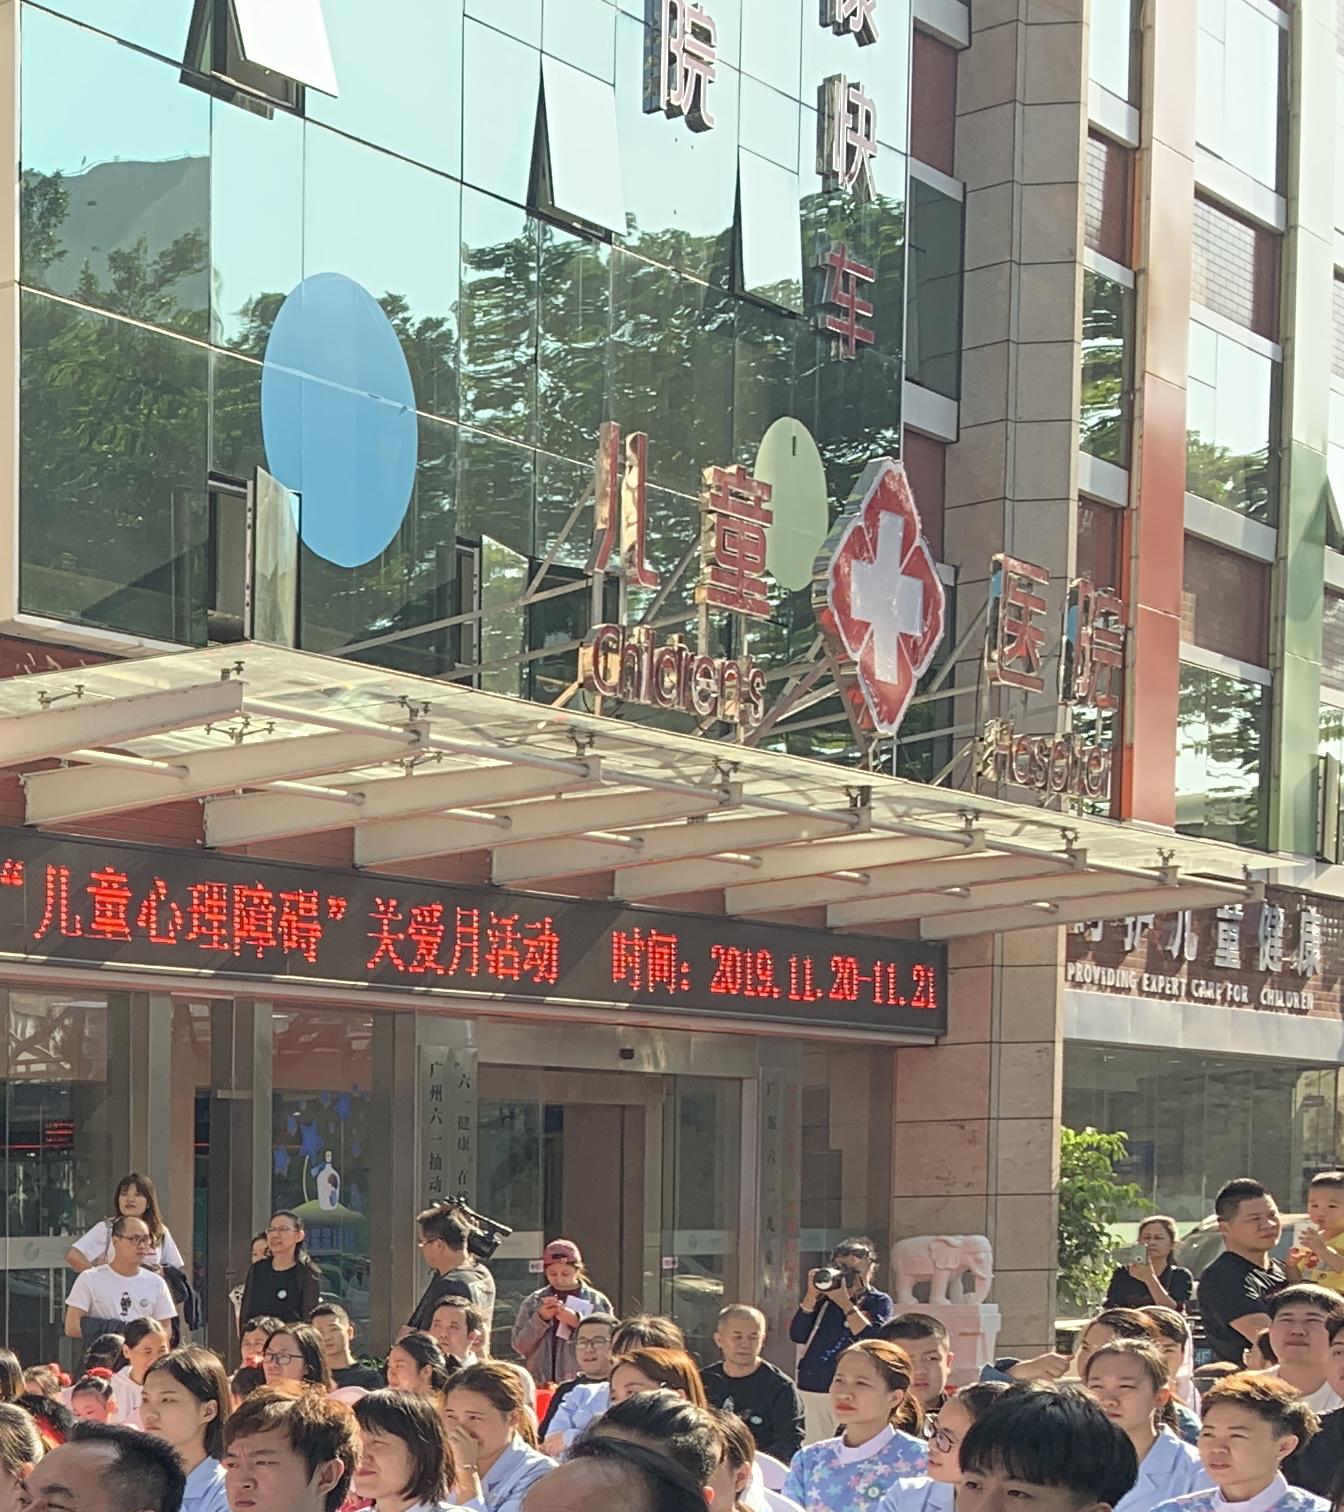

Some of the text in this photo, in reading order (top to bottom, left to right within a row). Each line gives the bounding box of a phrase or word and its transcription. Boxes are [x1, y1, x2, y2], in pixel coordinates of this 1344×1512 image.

[588, 420, 1126, 710] 儿童 医院
[1067, 962, 1314, 1011] PROVIDING EXPERT CARE FOR CHILDREN
